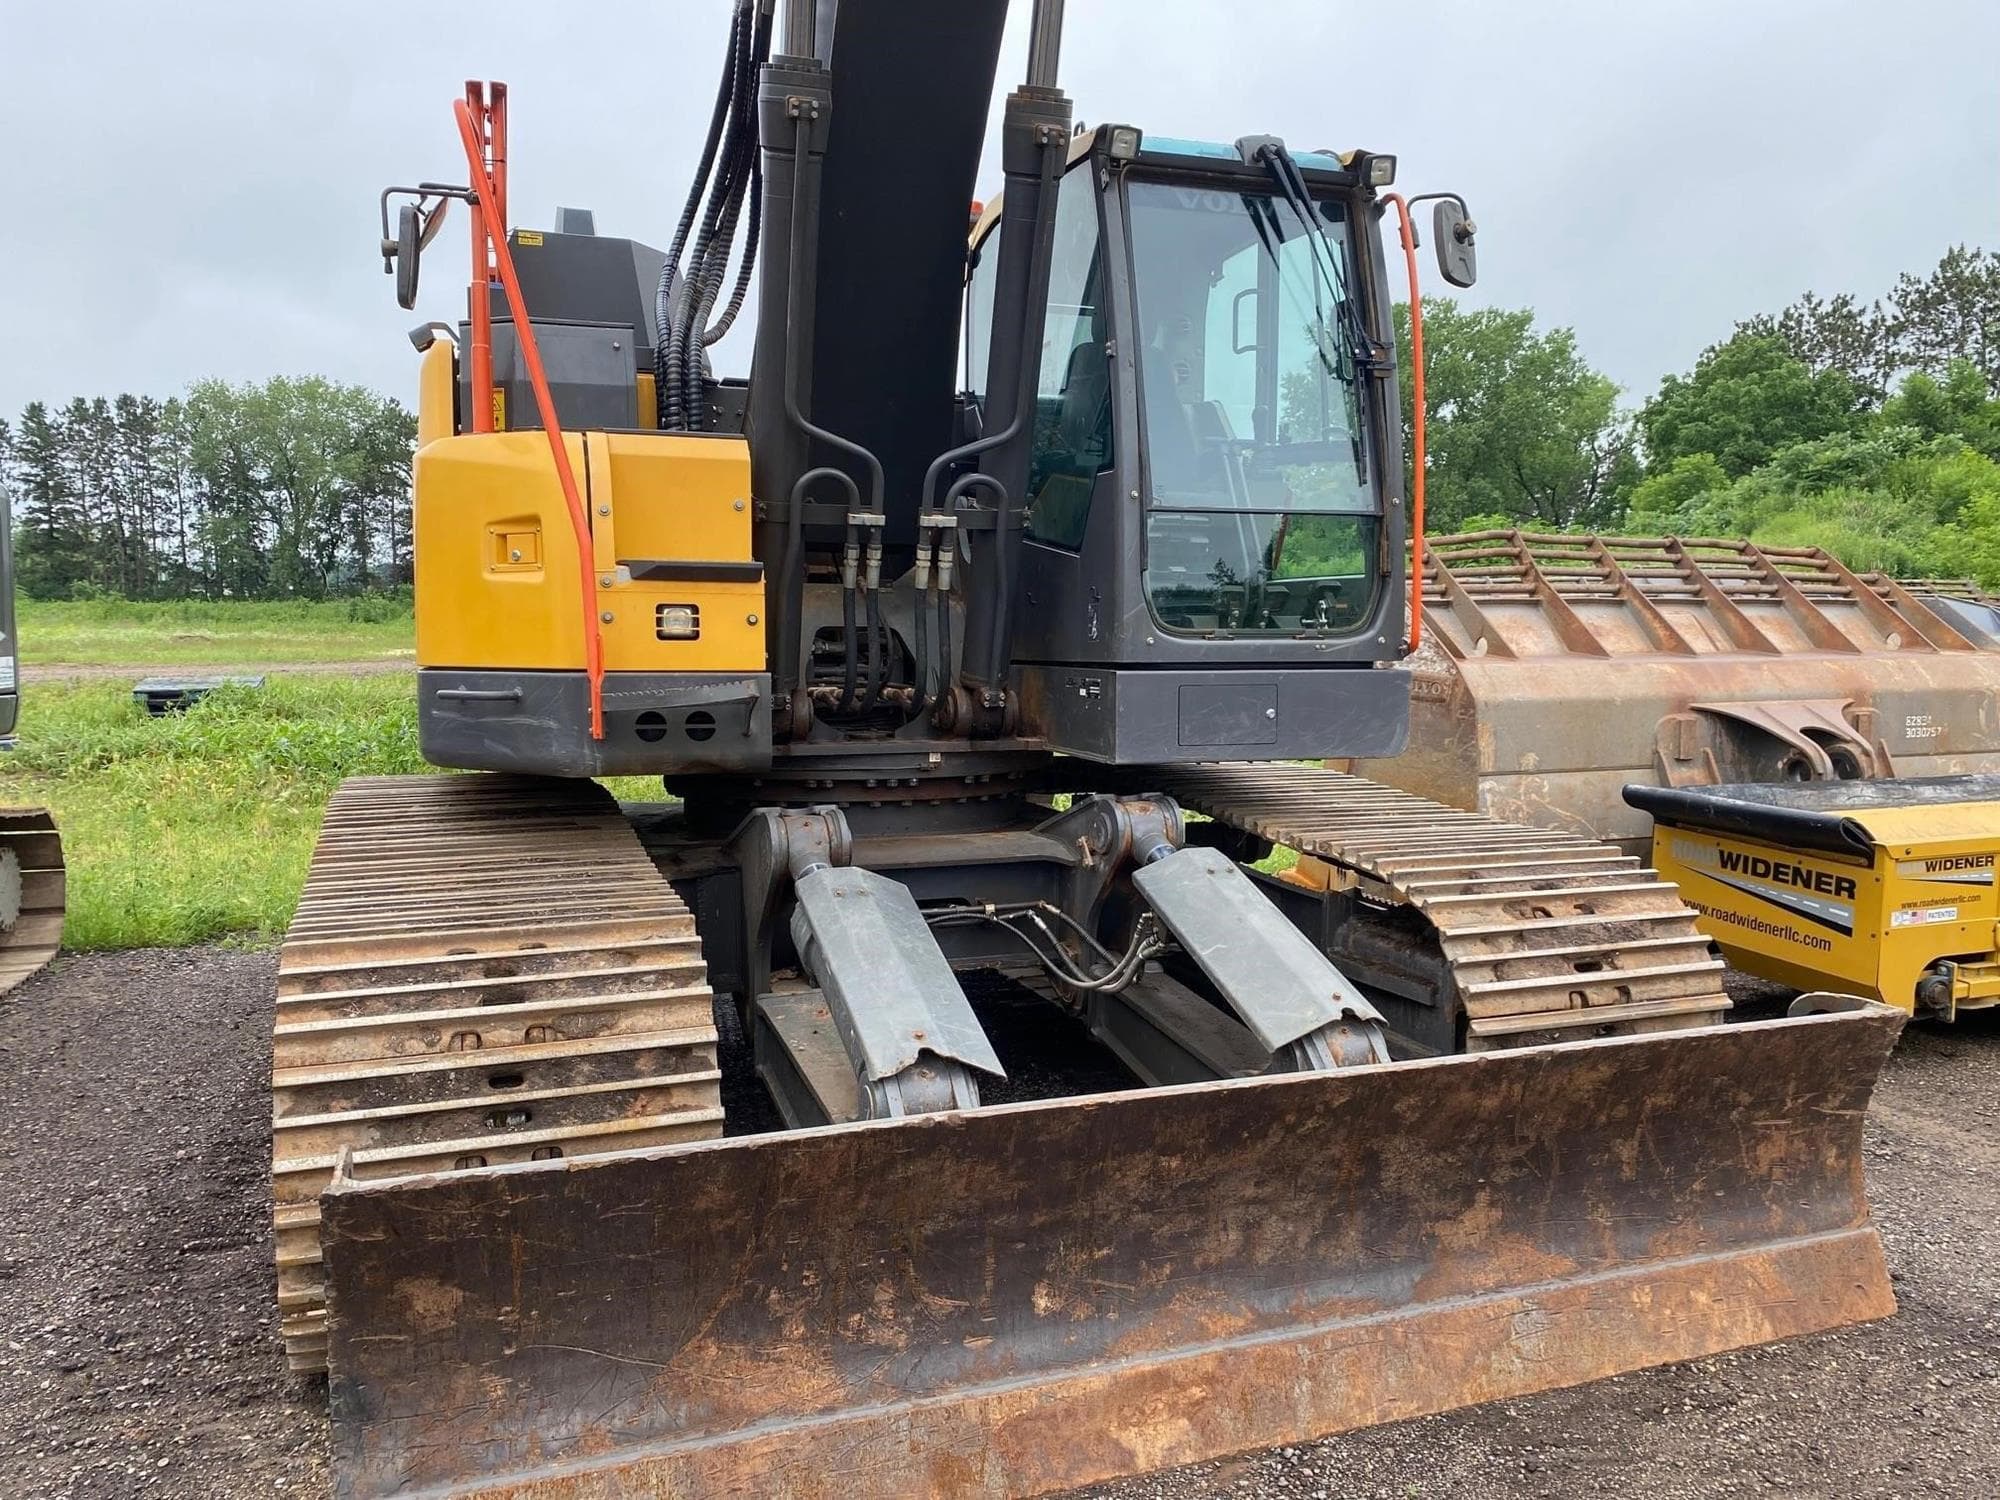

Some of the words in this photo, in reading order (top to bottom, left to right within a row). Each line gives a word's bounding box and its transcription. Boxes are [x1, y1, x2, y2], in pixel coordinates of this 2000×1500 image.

[1925, 855, 1995, 873] WIDENER
[1718, 849, 1857, 900] WIDENER
[1901, 894, 1981, 909] www.roadwidenerllc.com
